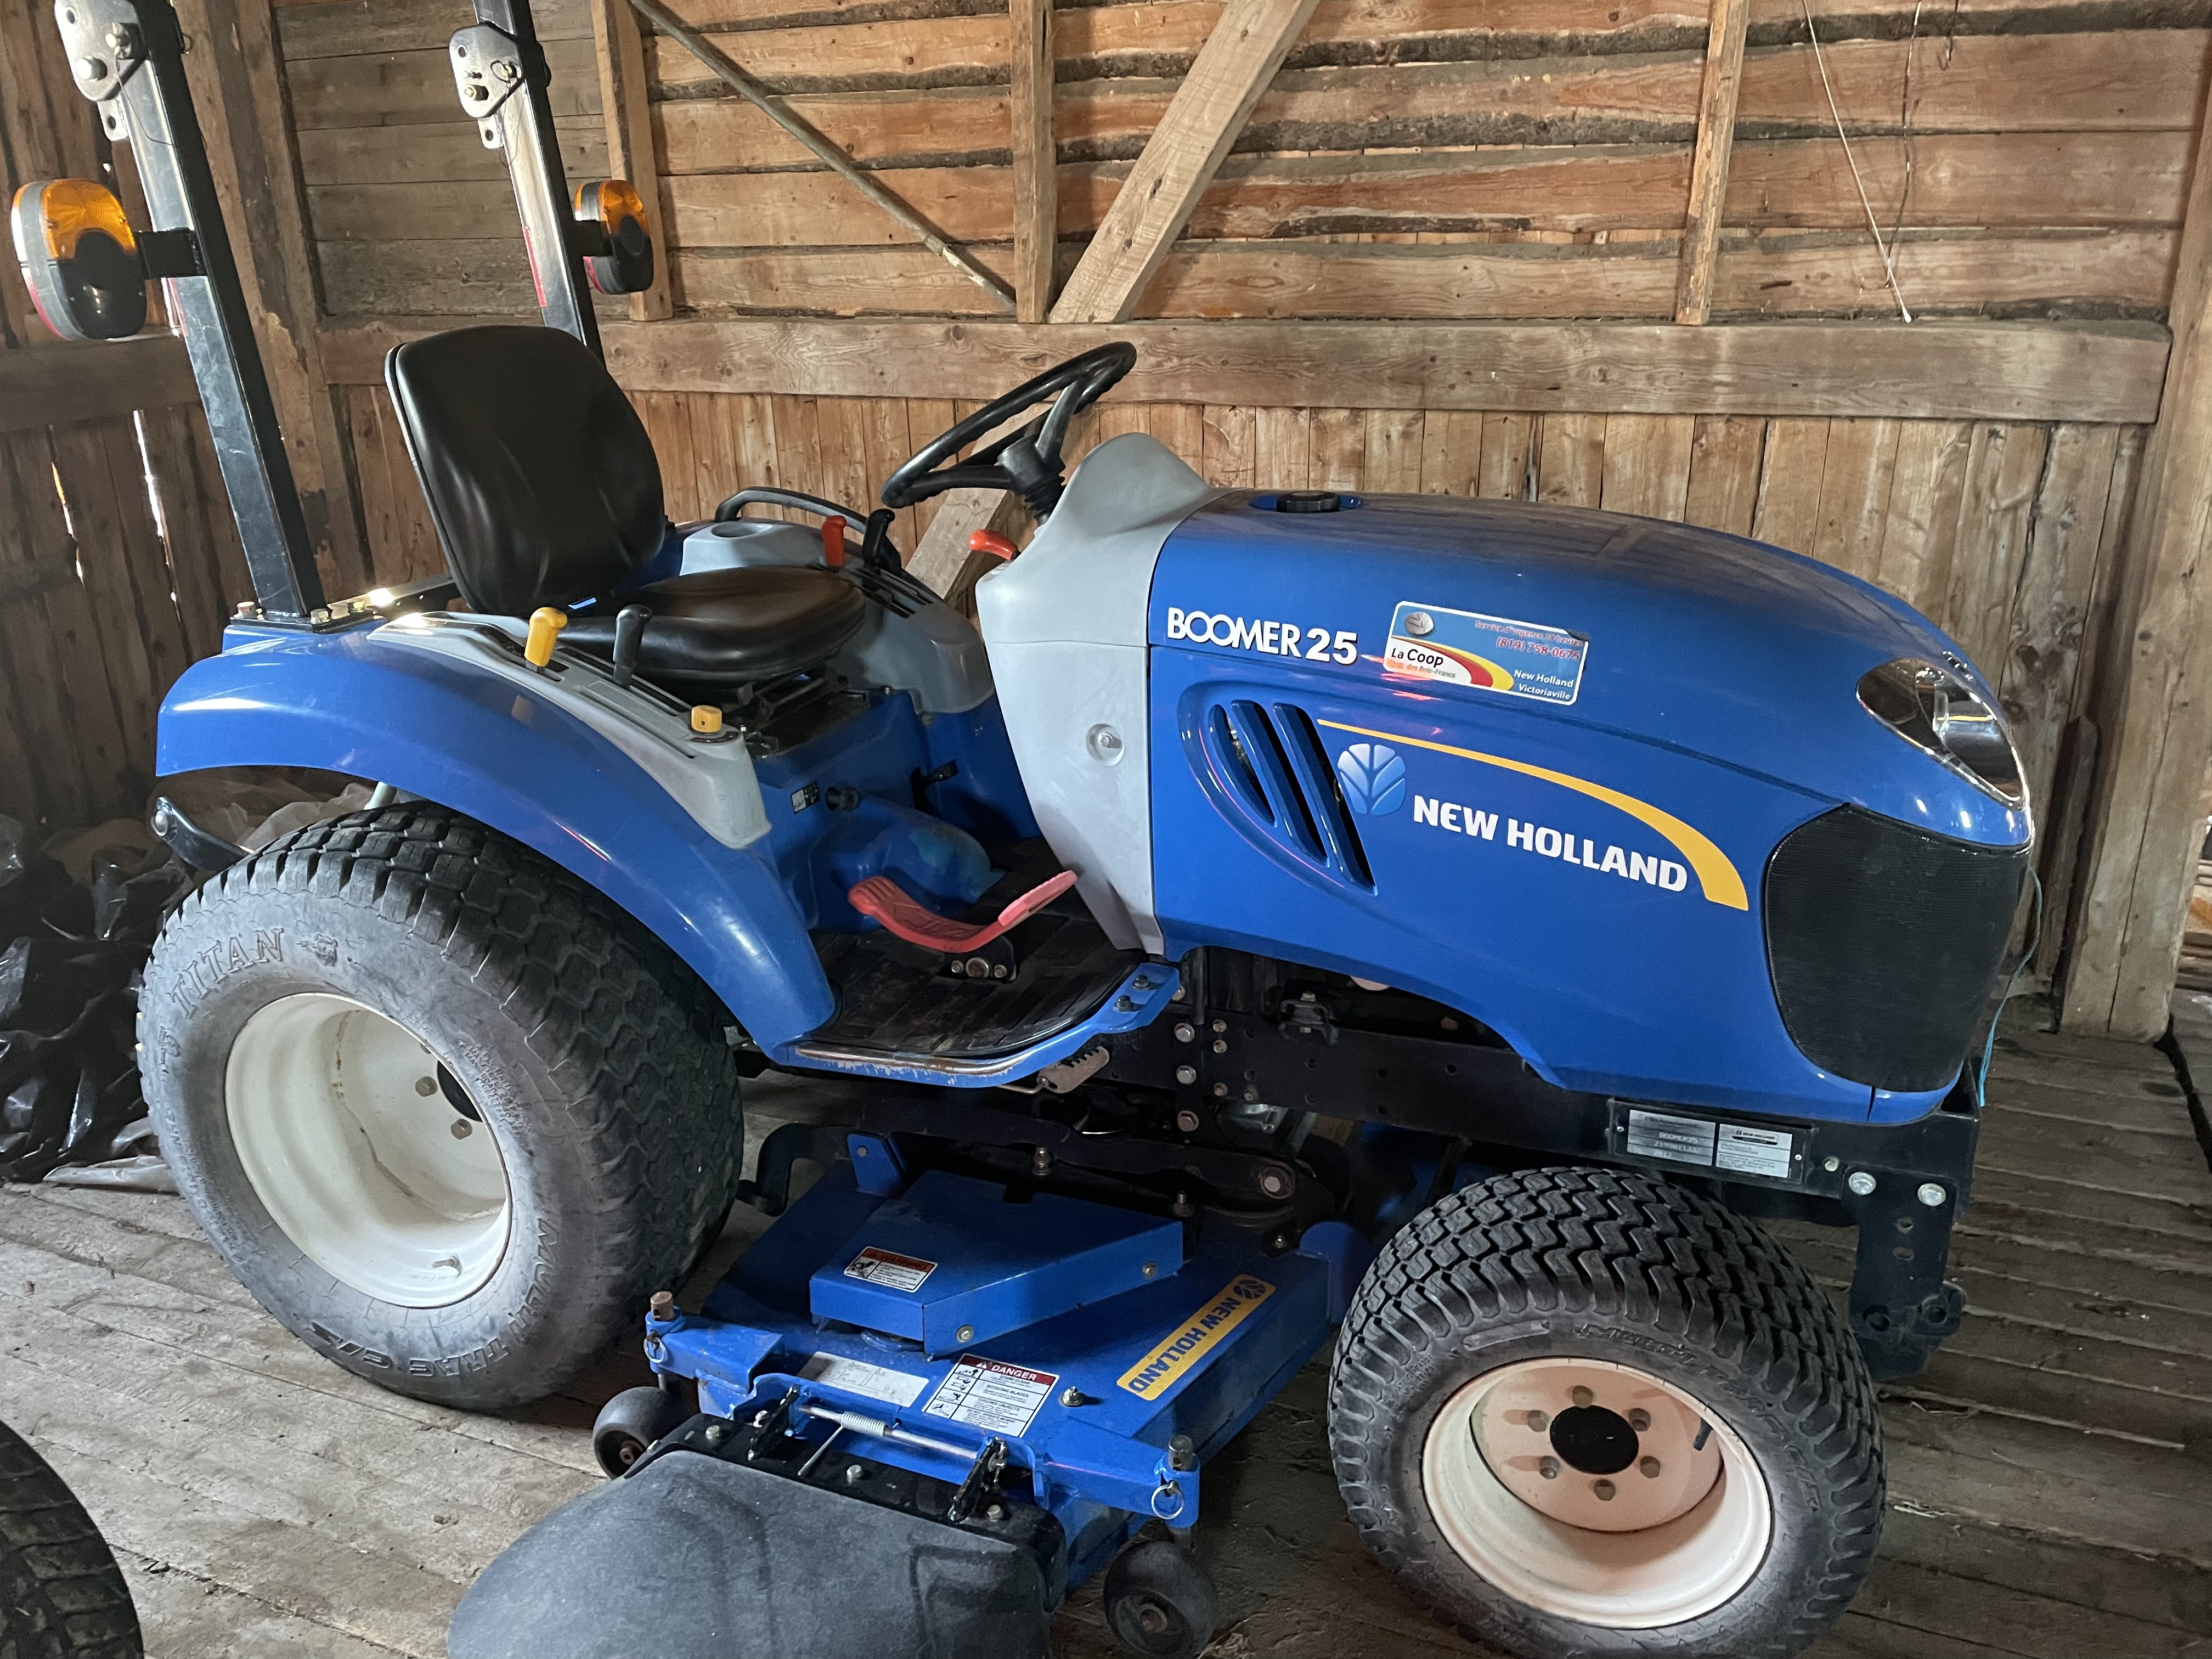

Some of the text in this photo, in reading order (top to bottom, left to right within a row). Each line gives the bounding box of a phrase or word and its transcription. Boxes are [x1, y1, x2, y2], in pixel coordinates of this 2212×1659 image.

[1167, 607, 1357, 665] BOOMER 25
[1475, 620, 1503, 632] Service
[1391, 648, 1404, 659] La
[1407, 648, 1443, 668] Coop
[1496, 636, 1581, 661] (819) 758-0675
[1514, 669, 1575, 688] New Holland
[1519, 683, 1571, 700] Victoriaville
[1413, 794, 1688, 893] NEW HOLLAND
[168, 927, 284, 1019] TITAN
[1128, 1297, 1242, 1392] NEW HOLLAND
[991, 1364, 1037, 1381] DANGER
